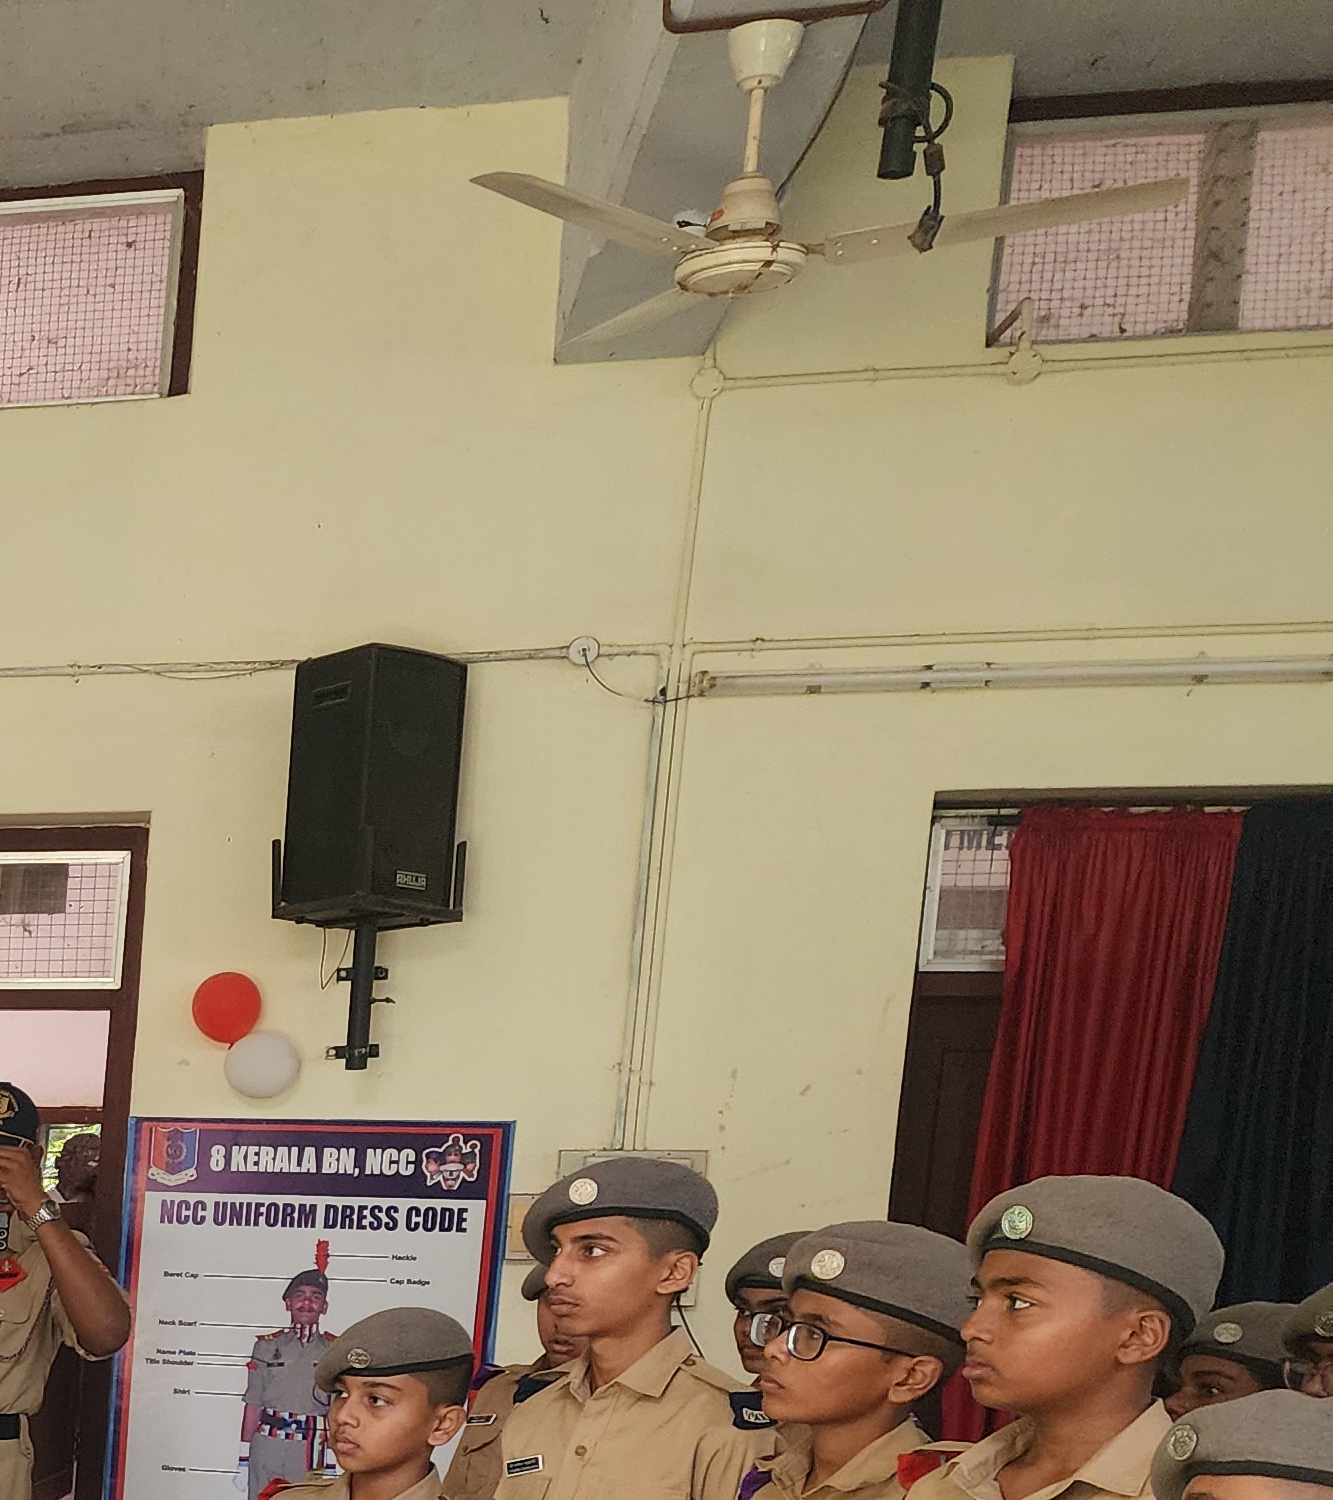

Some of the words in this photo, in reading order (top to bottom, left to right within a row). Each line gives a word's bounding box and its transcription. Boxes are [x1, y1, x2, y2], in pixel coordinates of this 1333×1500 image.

[396, 873, 427, 888] AHUJA
[210, 1144, 226, 1172] 8
[231, 1145, 317, 1174] KERALA
[321, 1147, 360, 1178] BN,
[365, 1148, 416, 1176] NCC
[160, 1199, 208, 1226] NCC
[213, 1201, 318, 1229] UNIFORM
[323, 1203, 399, 1231] DRESS
[405, 1206, 468, 1233] CODE
[391, 1254, 418, 1262] Hackle
[163, 1270, 183, 1278] Beret
[184, 1271, 200, 1279] Cap
[389, 1278, 405, 1286] Cap
[406, 1278, 431, 1287] Badge
[177, 1319, 198, 1327] Scarf
[156, 1347, 176, 1355] Name
[177, 1348, 197, 1356] Plate
[145, 1357, 161, 1365] Title
[161, 1358, 195, 1366] Shoulder
[173, 1387, 191, 1396] Shirt
[161, 1464, 186, 1472] Gloves
